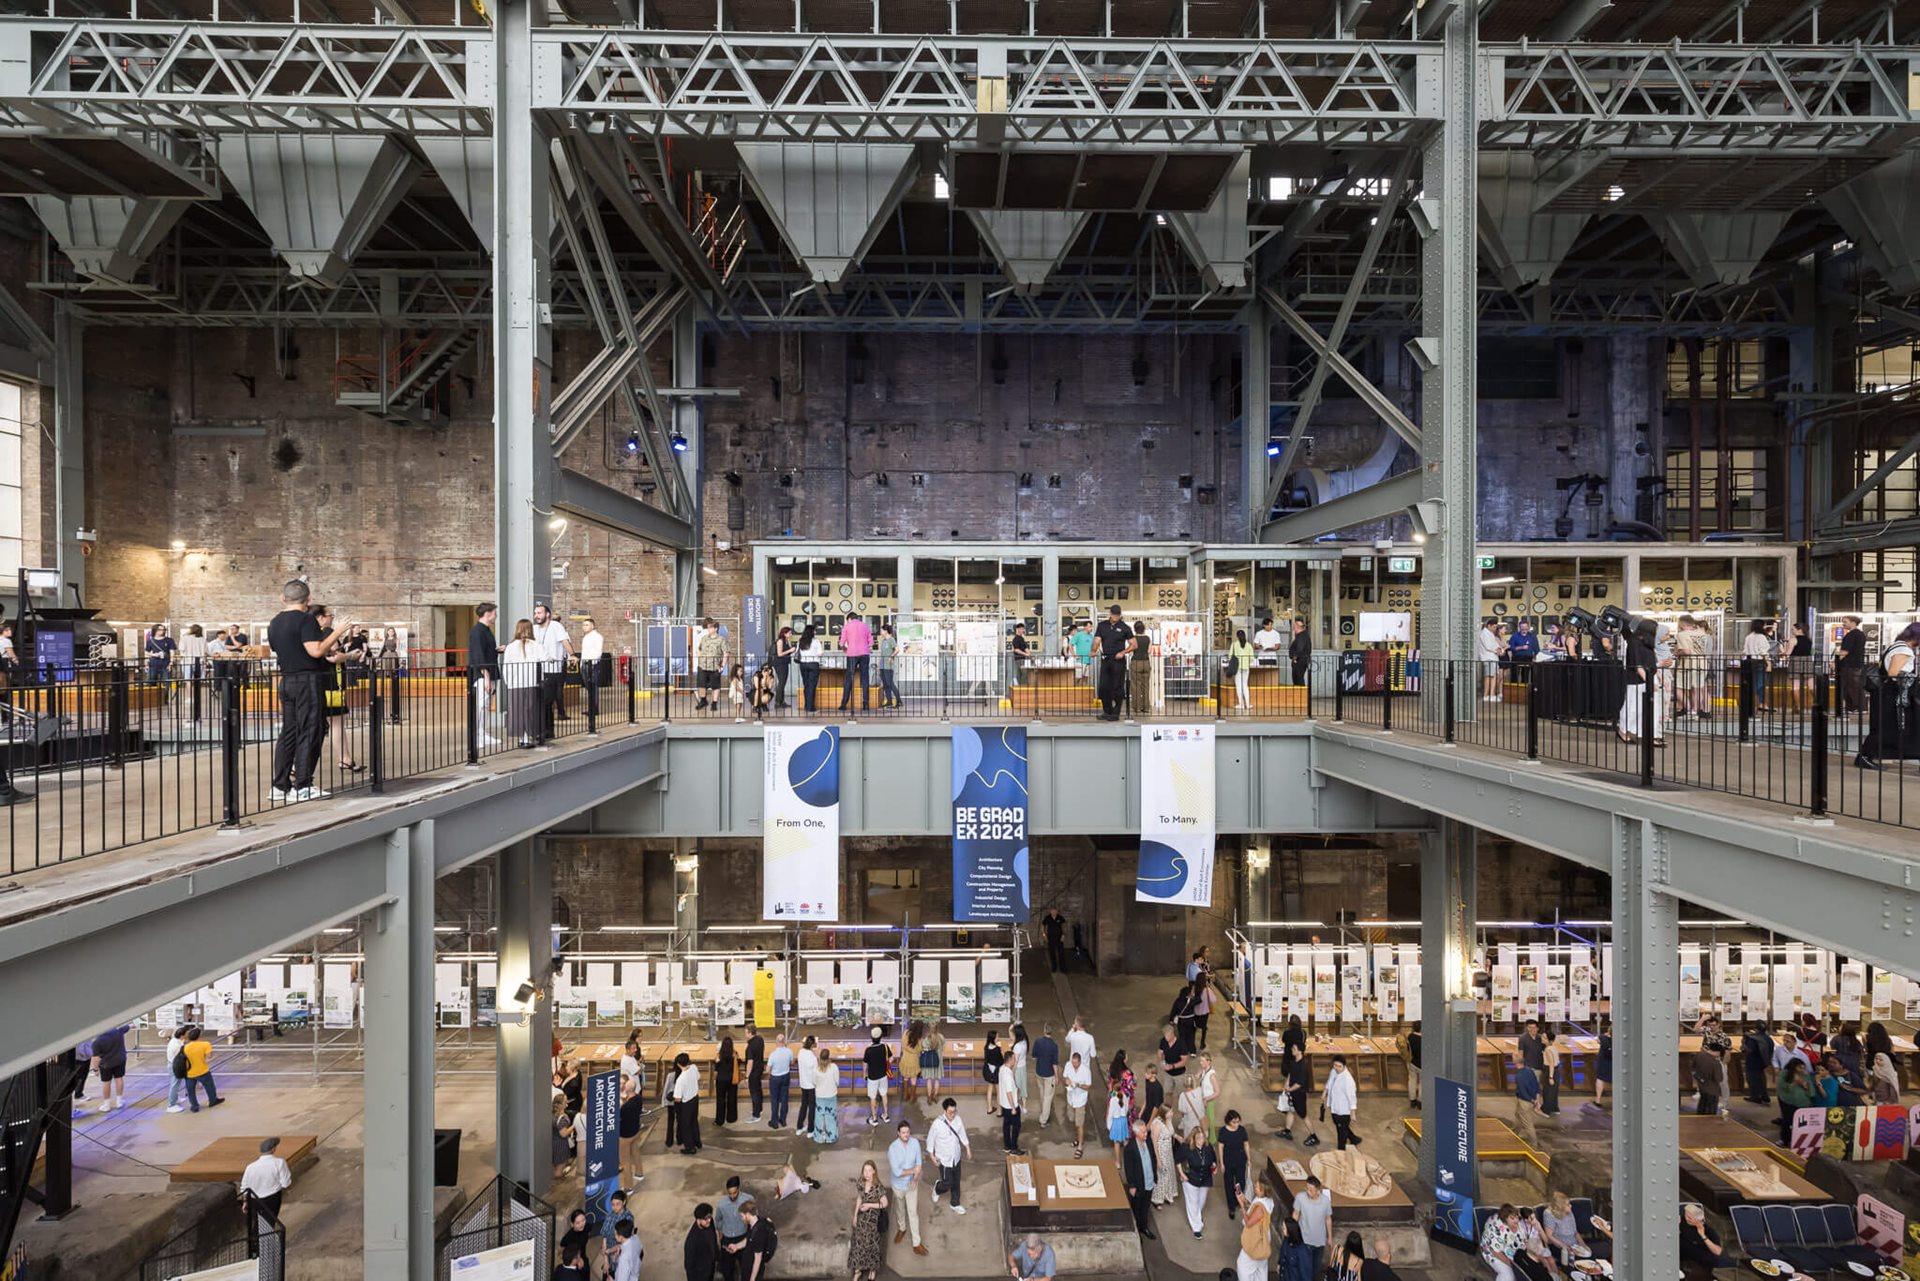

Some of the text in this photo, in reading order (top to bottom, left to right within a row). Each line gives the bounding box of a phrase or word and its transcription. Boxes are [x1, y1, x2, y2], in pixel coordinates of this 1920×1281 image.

[776, 818, 826, 828] From One,
[956, 807, 1024, 823] BE GRAD
[1159, 815, 1198, 825] To Many.
[956, 824, 1024, 840] EX 2024
[606, 1075, 615, 1132] LANDSCAPE
[595, 1079, 604, 1150] ARCHITECTURE
[1457, 1087, 1468, 1163] ARCHITECTURE
